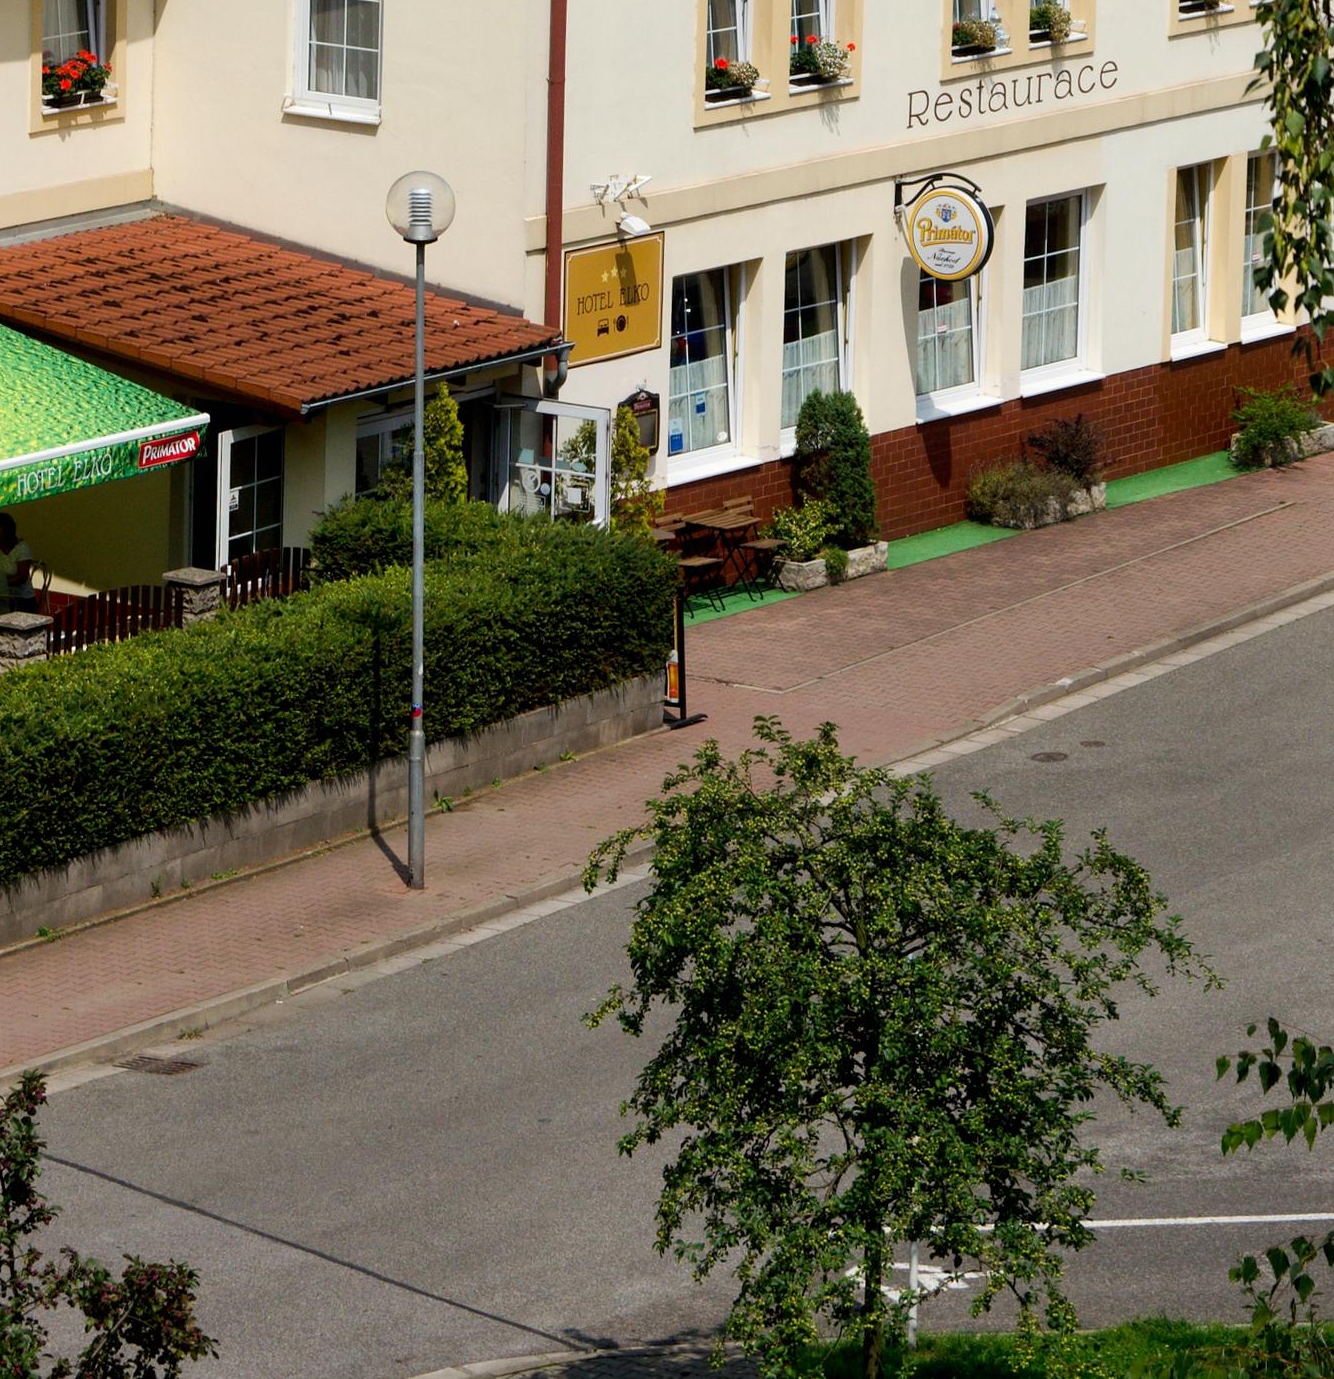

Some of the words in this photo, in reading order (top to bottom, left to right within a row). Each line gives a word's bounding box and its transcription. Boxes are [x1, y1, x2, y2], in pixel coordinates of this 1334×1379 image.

[907, 61, 1118, 129] Restaurace
[576, 291, 614, 315] HOTEL
[619, 282, 650, 306] ELKO
[16, 467, 67, 496] HOTEL
[72, 453, 114, 484] ELKO
